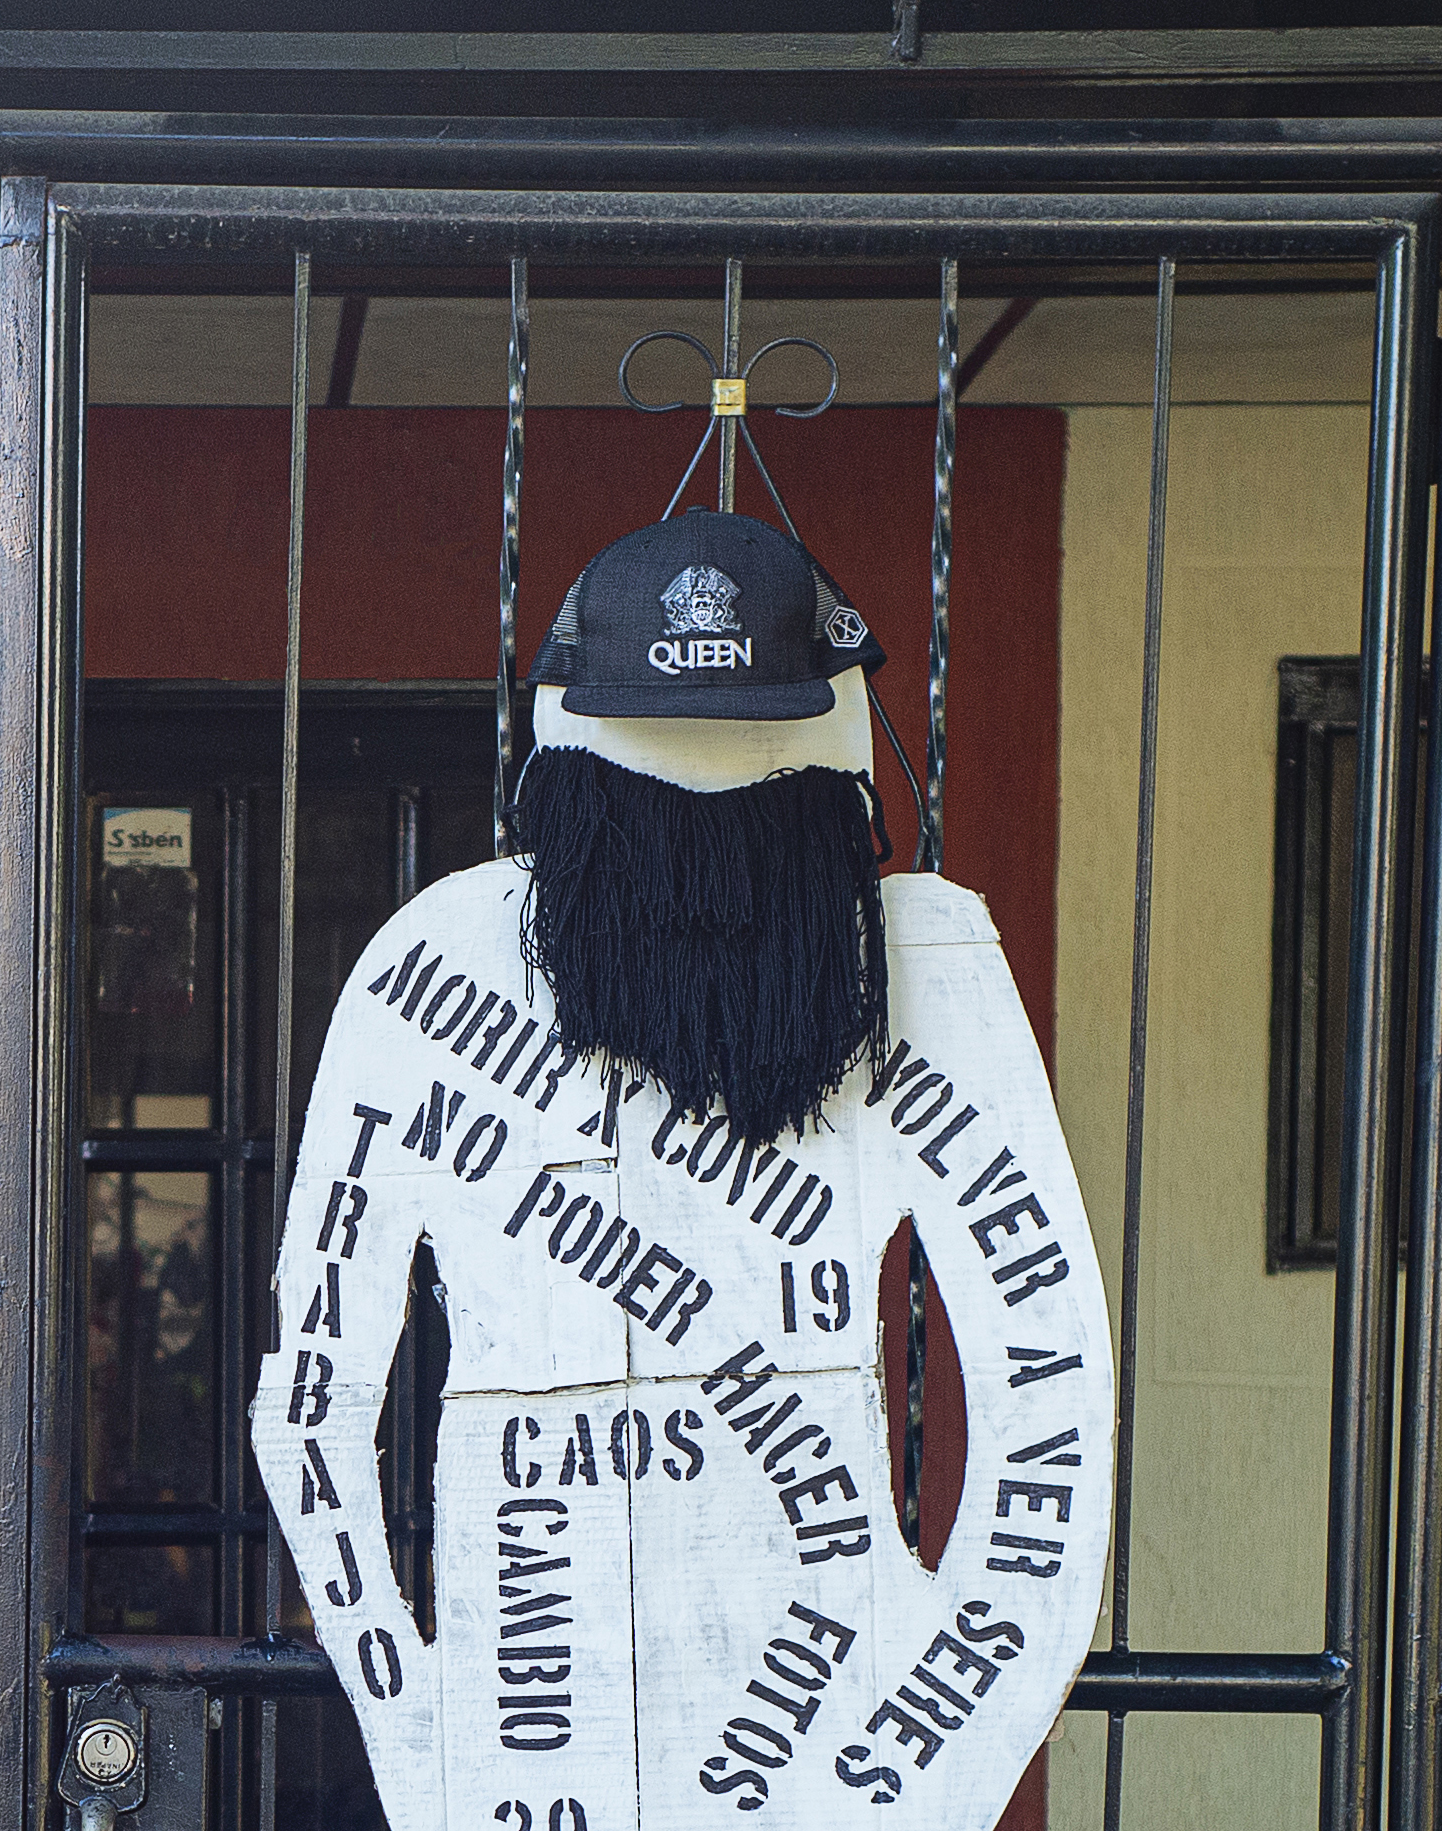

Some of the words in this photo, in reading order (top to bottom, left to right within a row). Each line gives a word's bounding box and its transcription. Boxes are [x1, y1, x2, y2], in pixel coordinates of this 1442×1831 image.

[647, 636, 753, 676] QUEEN
[107, 829, 183, 848] Ssben
[366, 940, 578, 1112] MORIR
[652, 1102, 833, 1246] COVID
[780, 1258, 852, 1335] 19
[401, 1080, 508, 1183] NO
[864, 1038, 1071, 1308] VOLVER
[504, 1170, 714, 1347] PODER
[287, 1102, 403, 1702] TRABAJO
[500, 1405, 706, 1492] CAOS
[701, 1340, 872, 1566] HACER
[1006, 1346, 1084, 1388] A
[985, 1427, 1083, 1580] VER
[496, 1498, 574, 1752] CAMBIO
[699, 1599, 858, 1812] FOTOS
[834, 1599, 1025, 1805] SERES
